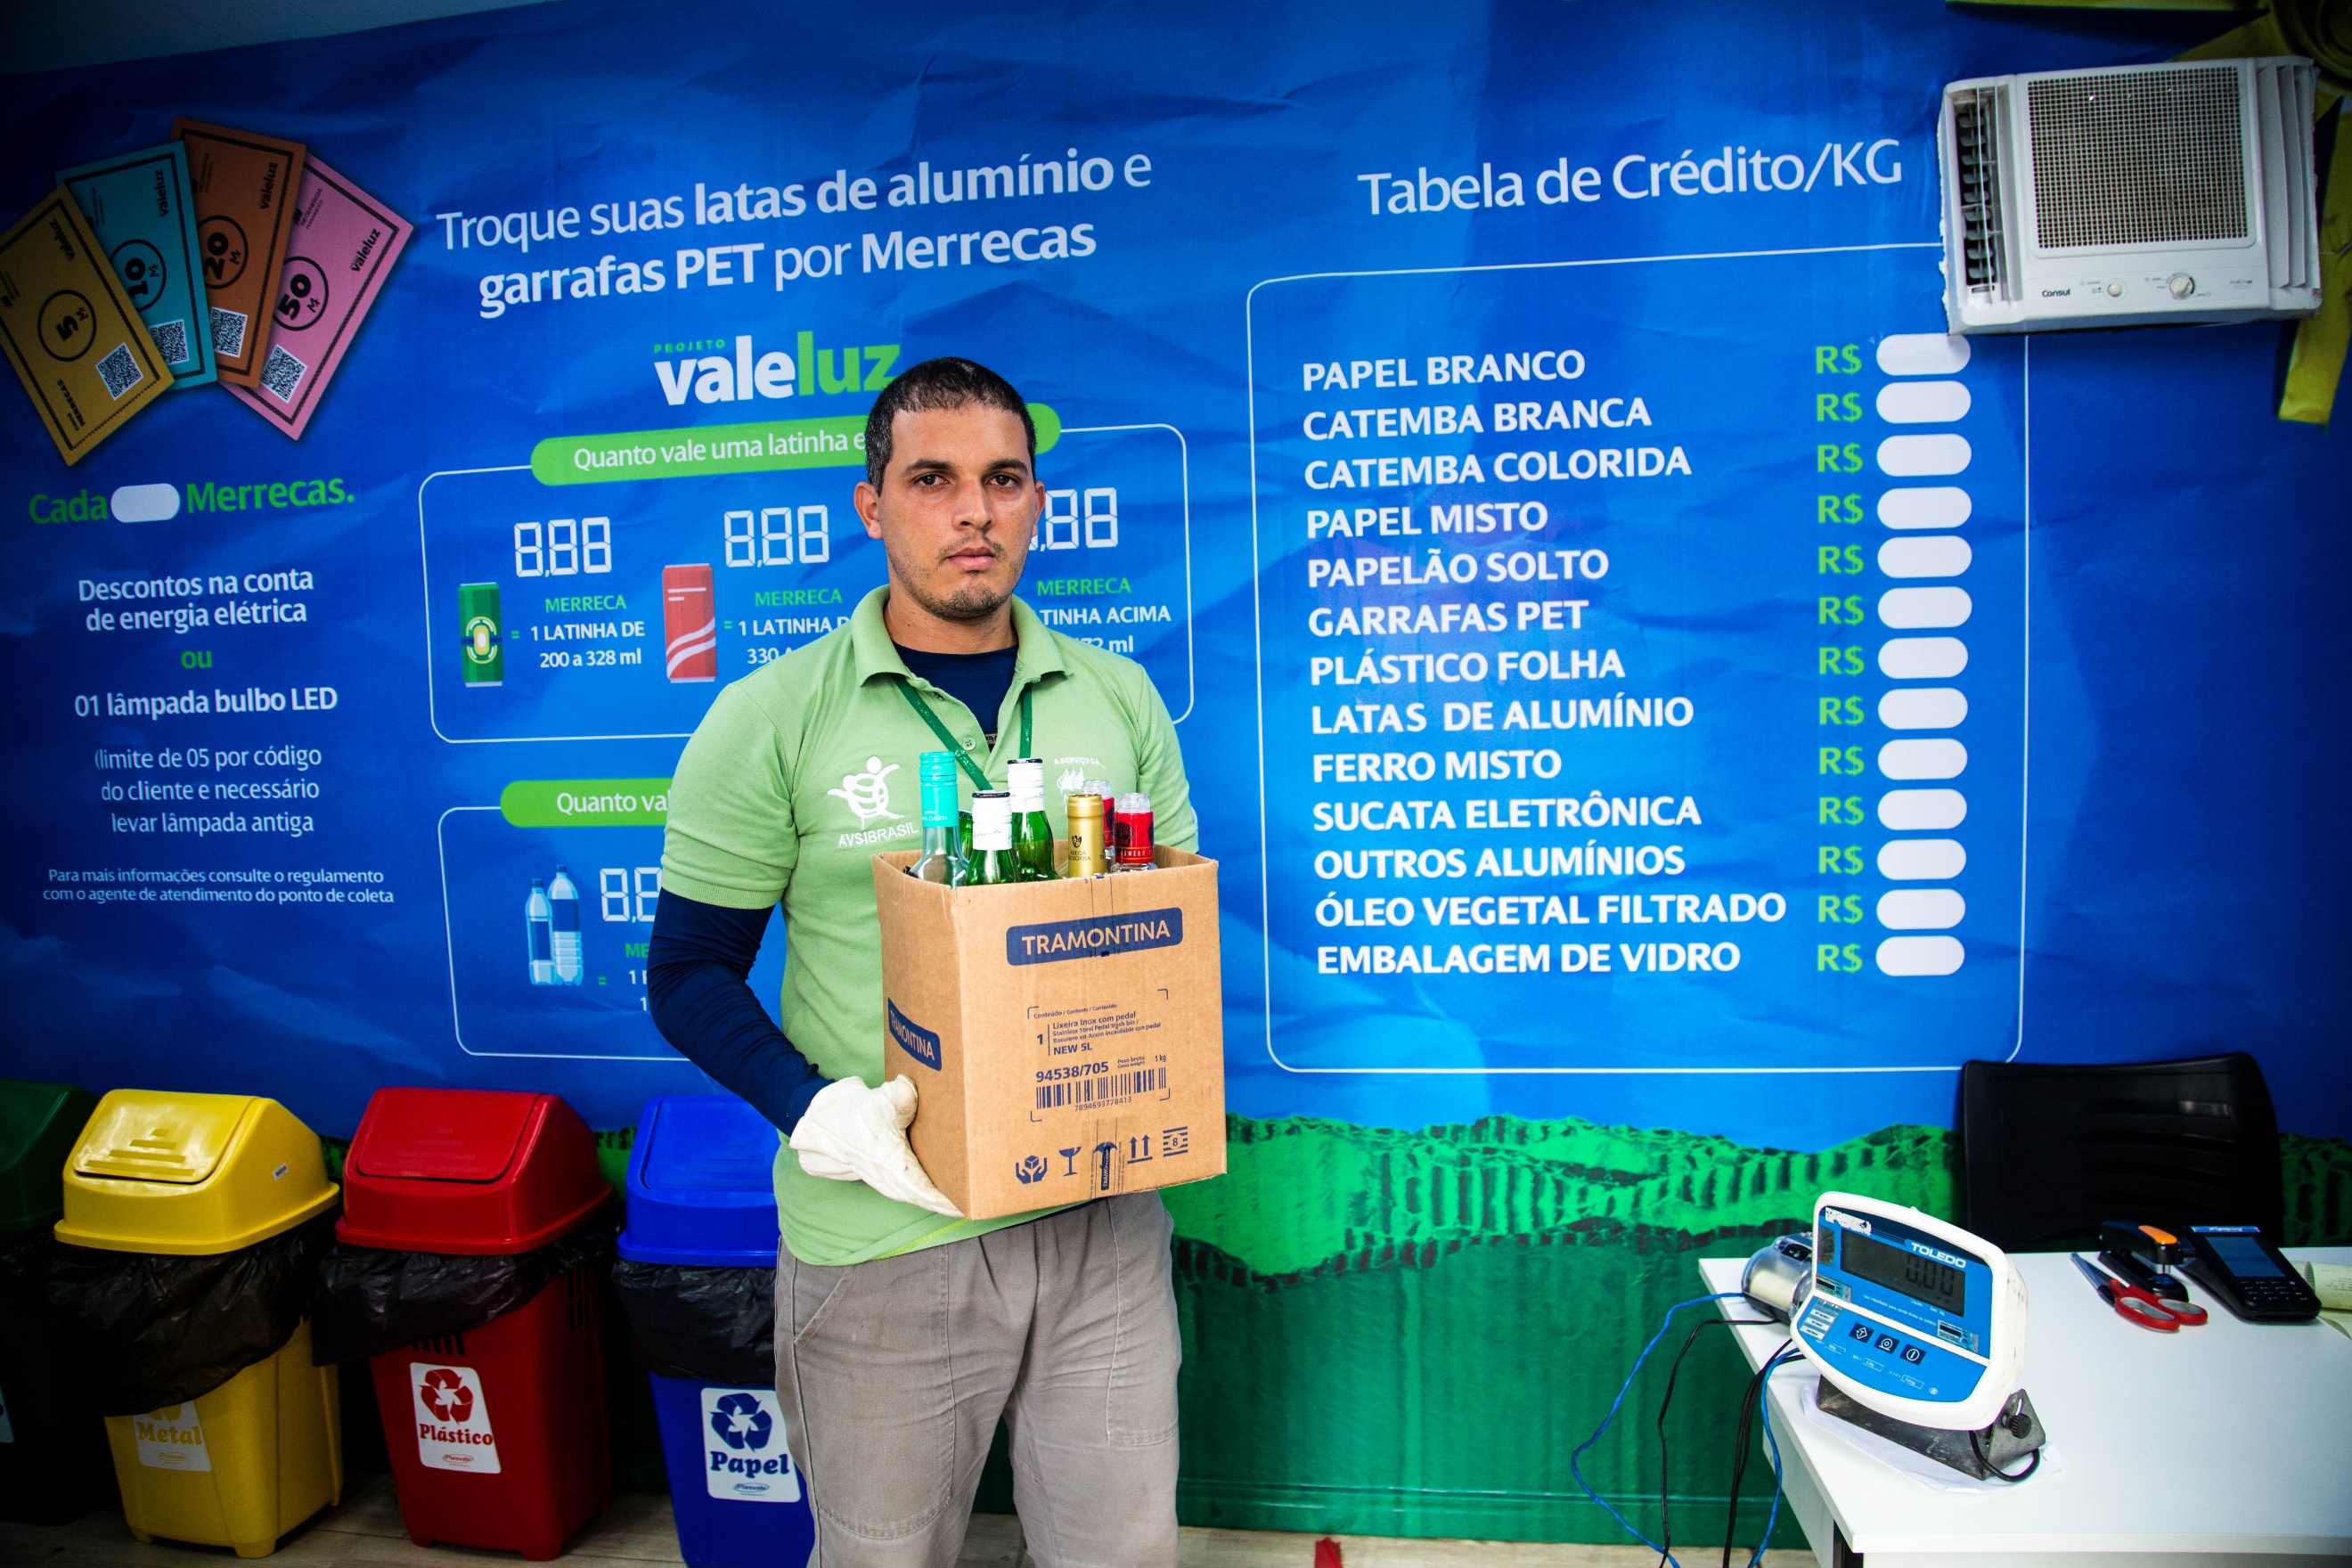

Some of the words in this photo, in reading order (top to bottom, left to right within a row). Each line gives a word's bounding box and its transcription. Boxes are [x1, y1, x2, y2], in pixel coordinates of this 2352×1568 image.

[1357, 162, 1526, 215] Tabela
[1536, 157, 1602, 205] de
[1613, 138, 1902, 200] Crédito/KG
[436, 207, 580, 253] Troque
[590, 195, 685, 236] suas
[695, 183, 806, 225] latas
[816, 168, 878, 214] de
[887, 147, 1115, 208] alumínio
[1123, 153, 1152, 187] e
[204, 233, 229, 279] 20
[353, 228, 381, 273] valeluz
[126, 257, 150, 300] 10
[478, 254, 666, 319] garrafas
[676, 242, 765, 290] PET
[774, 238, 852, 292] por
[862, 223, 1097, 274] Merrecas
[279, 274, 311, 320] 50
[2041, 288, 2071, 298] Consul
[56, 316, 79, 341] 5
[653, 338, 726, 355] PROJETO
[654, 331, 901, 405] valeluz
[1303, 358, 1418, 391] PAPEL
[1426, 349, 1586, 386] BRANCO
[1816, 343, 1863, 375] R$
[1303, 404, 1484, 441] CATEMBA
[1494, 396, 1653, 432] BRANCA
[574, 445, 657, 472] Quanto
[660, 438, 706, 463] vale
[711, 439, 764, 460] uma
[768, 429, 849, 456] latinha
[1304, 453, 1486, 490] CATEMBA
[1493, 445, 1693, 483] COLORIDA
[29, 488, 109, 525] Cada
[186, 478, 355, 514] Merrecas.
[1307, 506, 1423, 539] PAPEL
[1430, 501, 1548, 535] MISTO
[1308, 548, 1478, 588] PAPELÃO
[1486, 549, 1609, 583] SOLTO
[78, 576, 203, 601] Descontos
[208, 575, 238, 595] na
[243, 568, 314, 593] conta
[755, 587, 843, 607] MERRECA
[1037, 576, 1132, 596] MERRECA
[86, 608, 114, 632] de
[118, 602, 209, 634] energia
[214, 598, 307, 625] elétrica
[544, 594, 627, 613] MERRECA
[1106, 605, 1172, 624] ACIMA
[530, 625, 538, 641] 1
[543, 622, 618, 641] LATINHA
[621, 620, 645, 638] DE
[739, 620, 747, 636] 1
[752, 617, 833, 637] LATINHA
[1308, 601, 1508, 637] GARRAFAS
[1517, 600, 1589, 631] PET
[539, 651, 570, 668] 200
[572, 654, 583, 667] a
[585, 649, 617, 666] 328
[619, 647, 641, 666] ml
[747, 647, 780, 665] 330
[1108, 634, 1134, 654] ml
[181, 650, 212, 669] ou
[1311, 648, 1489, 686] PLÁSTICO
[1498, 649, 1626, 682] FOLHA
[74, 695, 98, 717] 01
[106, 690, 209, 721] lâmpada
[214, 687, 286, 713] bulbo
[290, 687, 338, 711] LED
[1311, 698, 1427, 735] LATAS
[1443, 701, 1494, 731] DE
[1501, 691, 1695, 731] ALUMÍNIO
[94, 748, 153, 771] (limite
[158, 747, 182, 768] de
[186, 747, 209, 768] 05
[215, 751, 249, 772] por
[253, 745, 322, 772] código
[1313, 751, 1436, 783] FERRO
[1445, 748, 1563, 780] MISTO
[101, 781, 124, 801] do
[127, 780, 193, 801] cliente
[198, 784, 209, 800] e
[214, 778, 320, 799] necessário
[556, 792, 637, 816] Quanto
[110, 813, 158, 833] levar
[161, 812, 247, 837] lâmpada
[250, 812, 314, 837] antiga
[1312, 800, 1457, 832] SUCATA
[1466, 789, 1703, 829] ELETRÔNICA
[1314, 848, 1467, 879] OUTROS
[1474, 838, 1686, 878] ALUMÍNIOS
[48, 869, 79, 882] Para
[81, 868, 116, 882] mais
[118, 869, 206, 883] informações
[208, 869, 271, 883] consulte
[274, 871, 284, 883] o
[287, 869, 384, 886] regulamento
[42, 889, 73, 901] com
[75, 889, 86, 900] o
[87, 889, 136, 904] agente
[138, 887, 156, 901] de
[159, 887, 253, 902] atendimento
[254, 887, 275, 902] do
[278, 890, 323, 905] ponto
[325, 888, 345, 902] de
[347, 888, 394, 903] coleta
[1315, 891, 1415, 927] ÓLEO
[1421, 895, 1590, 927] VEGETAL
[1598, 892, 1787, 924] FILTRADO
[1021, 919, 1171, 956] TRAMONTINA
[1318, 943, 1550, 974] EMBALAGEM
[1561, 943, 1612, 973] DE
[1619, 942, 1741, 972] VIDRO
[1817, 943, 1863, 973] R$
[1033, 1010, 1063, 1019] Conteúdo
[1052, 1020, 1079, 1030] Lixeira
[1080, 1017, 1097, 1026] Inox
[1098, 1016, 1115, 1024] com
[1115, 1010, 1137, 1023] pedal
[889, 1009, 935, 1061] TRAMONTINA
[1036, 1033, 1044, 1046] 1
[1052, 1029, 1079, 1037] Stainless
[1079, 1025, 1094, 1033] Steel
[1094, 1023, 1111, 1031] Pedal
[1052, 1035, 1079, 1044] Basurero
[1105, 1026, 1134, 1036] inoxidable
[1146, 1022, 1162, 1032] pedal
[1053, 1043, 1078, 1056] NEW
[1081, 1042, 1093, 1052] 5L
[1035, 1060, 1110, 1083] 94538/705
[1159, 1054, 1167, 1063] kg
[1172, 1137, 1179, 1147] 8
[1910, 1241, 1968, 1270] TOLEDO
[136, 1421, 203, 1446] Metal
[419, 1423, 494, 1446] Plástico
[709, 1450, 790, 1479] Papel
